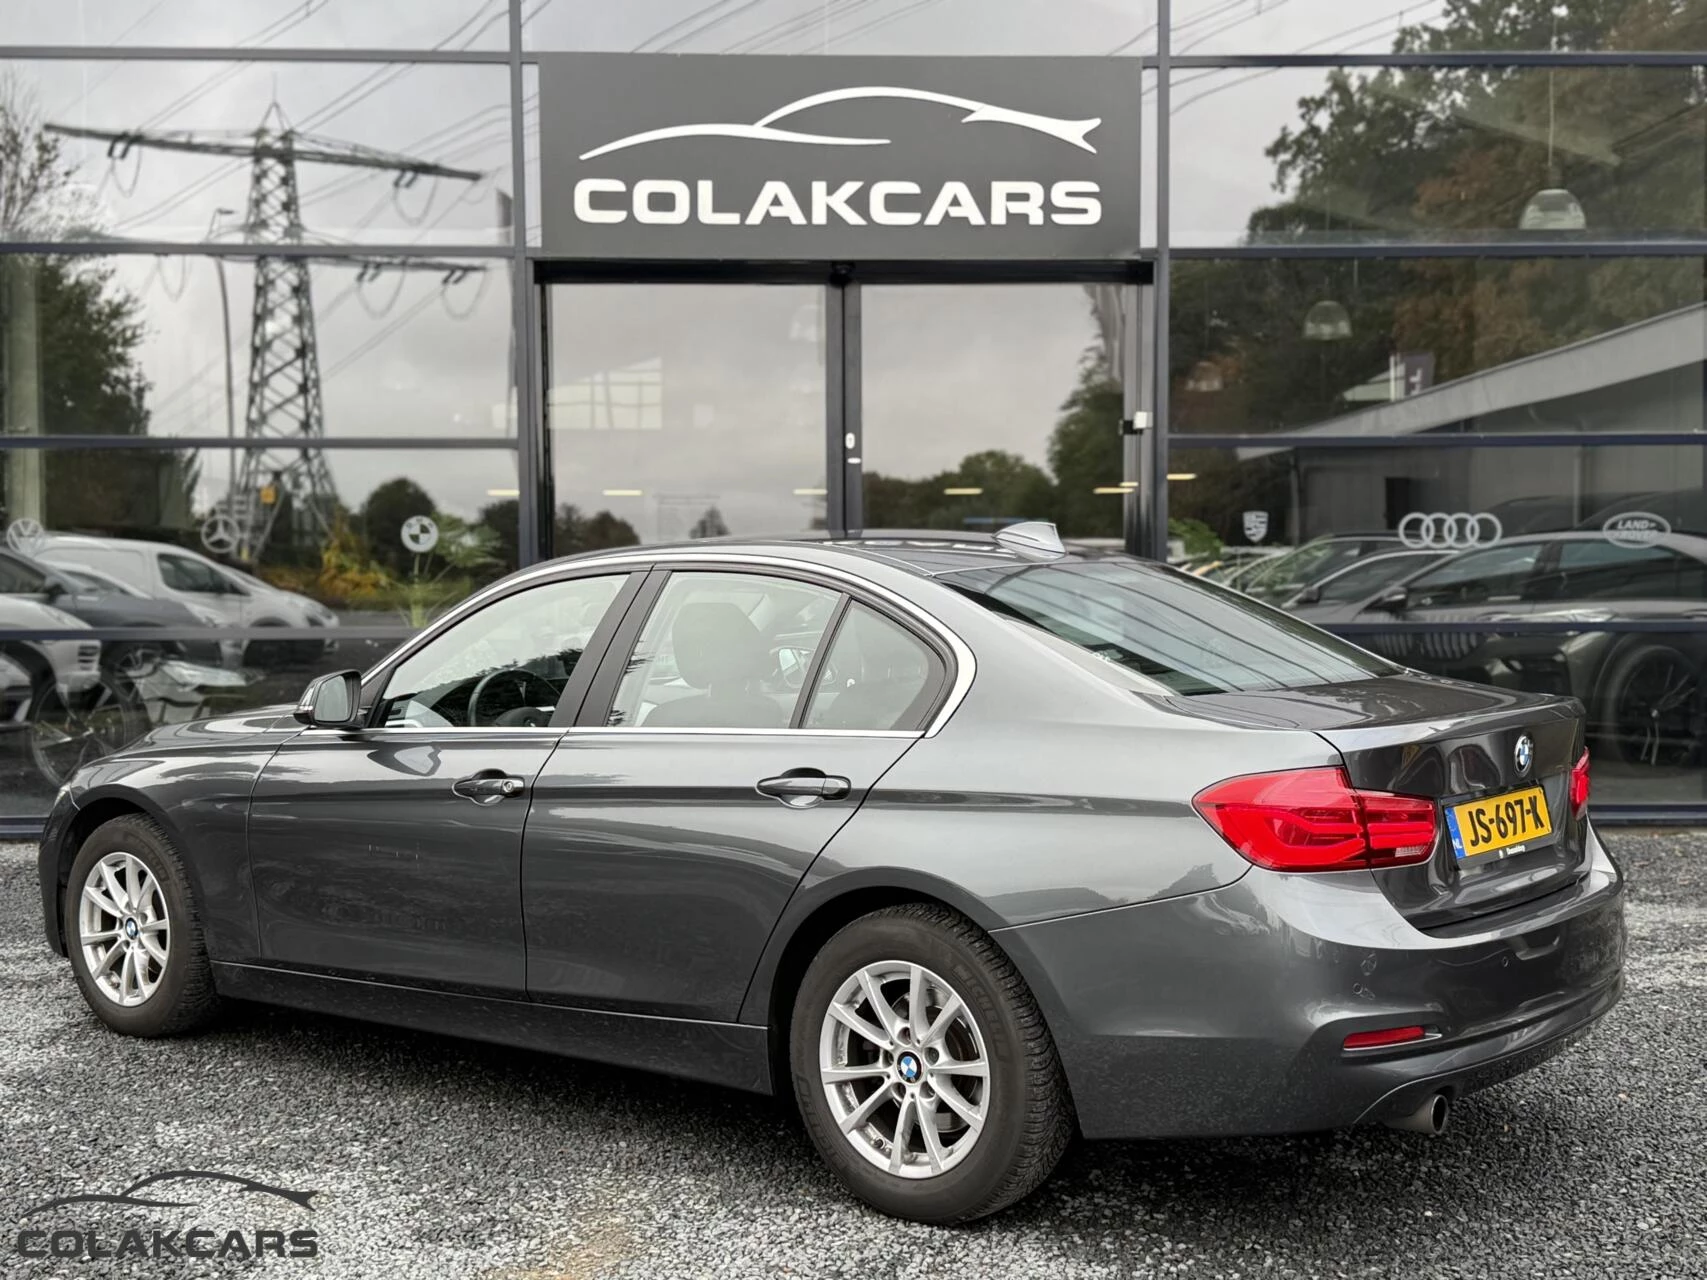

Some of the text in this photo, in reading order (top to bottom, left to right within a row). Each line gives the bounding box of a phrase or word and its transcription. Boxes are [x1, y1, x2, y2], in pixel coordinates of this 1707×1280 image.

[573, 178, 1102, 226] COLAKCARS
[1617, 519, 1649, 529] LAND
[1467, 795, 1545, 847] JS-697-K
[1452, 838, 1463, 850] NL
